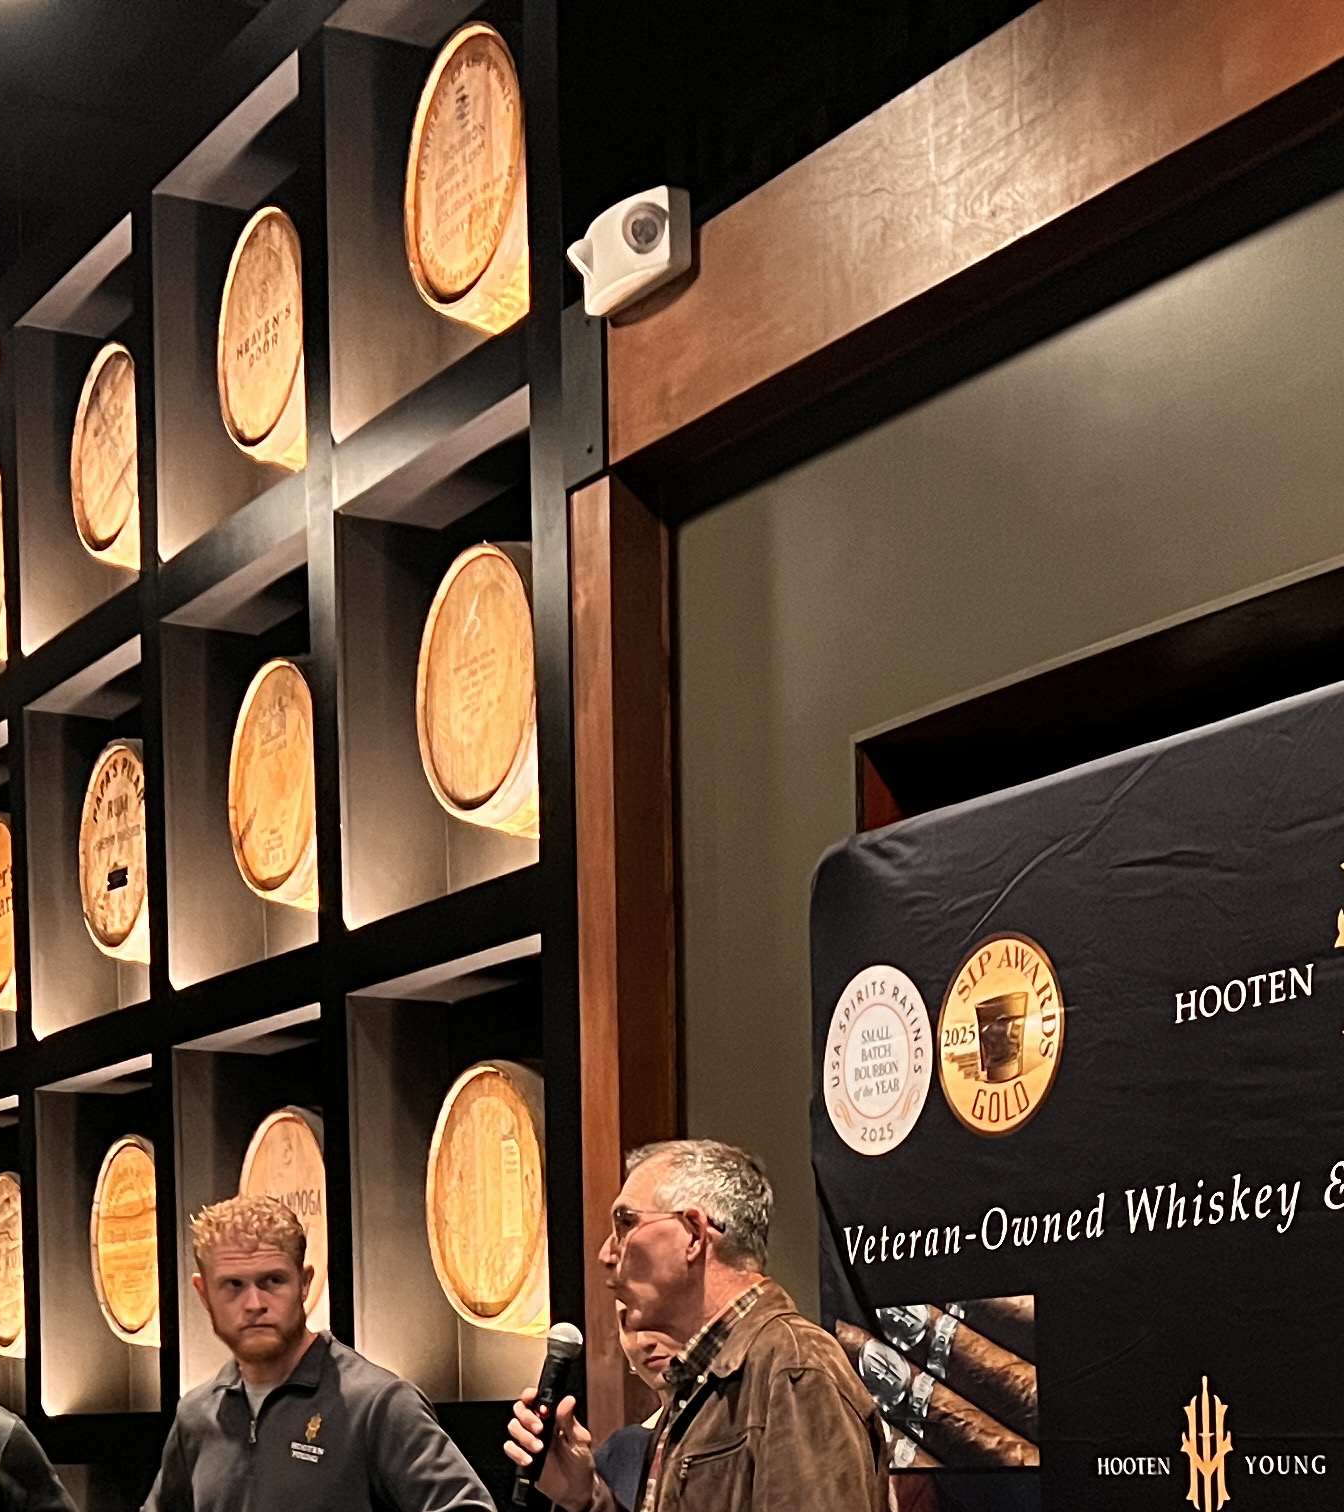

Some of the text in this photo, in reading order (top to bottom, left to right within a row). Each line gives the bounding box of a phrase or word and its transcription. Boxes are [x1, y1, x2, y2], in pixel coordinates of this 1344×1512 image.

[237, 302, 291, 362] HEAVEN'S
[249, 332, 278, 368] DOOR
[93, 758, 118, 823] PAPA'S
[957, 945, 1057, 1059] SIP AWARDS
[1174, 963, 1315, 1024] HOOTEN
[831, 980, 924, 1089] USA SPIRITS RATINGS
[860, 1043, 892, 1061] BATCH
[861, 1026, 892, 1043] SMALL
[943, 1025, 976, 1048] 2025
[854, 1060, 898, 1082] BOURBON
[875, 1078, 900, 1094] YEAR
[971, 1080, 1030, 1123] GOLD
[860, 1122, 894, 1142] 2025
[843, 1192, 1106, 1266] Veteran-Owned
[1125, 1173, 1301, 1234] Whiskey
[1097, 1455, 1327, 1476] HOOTEN YOUNG
